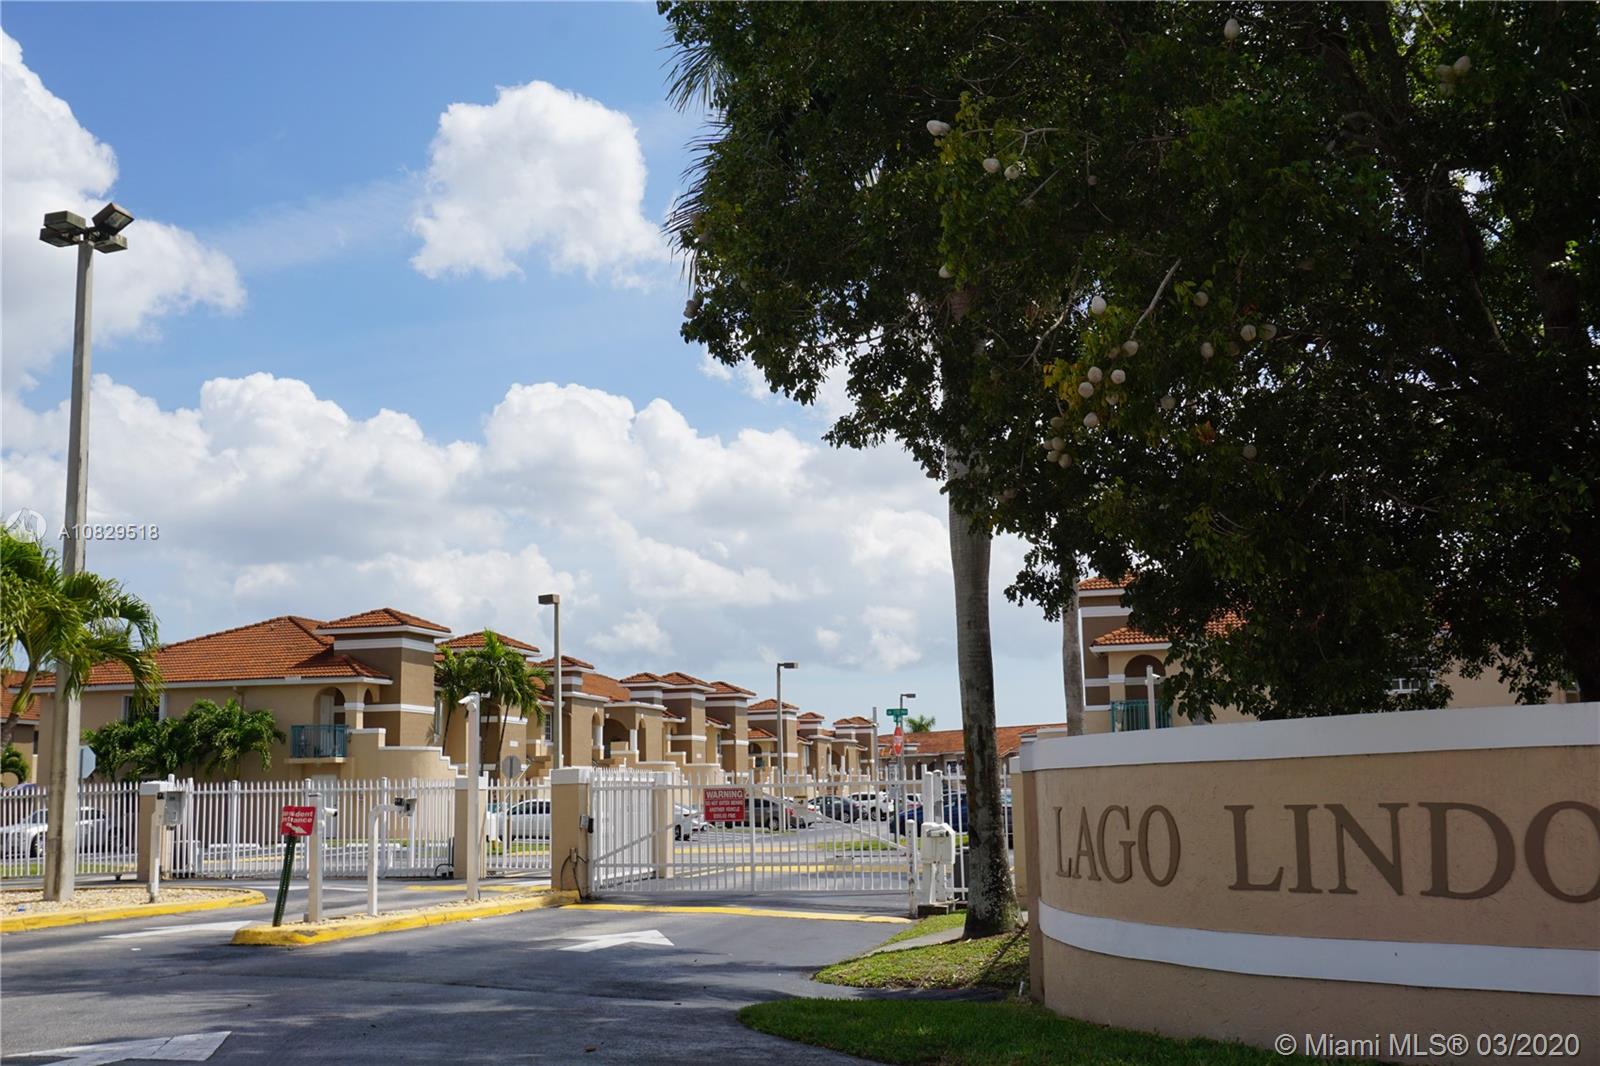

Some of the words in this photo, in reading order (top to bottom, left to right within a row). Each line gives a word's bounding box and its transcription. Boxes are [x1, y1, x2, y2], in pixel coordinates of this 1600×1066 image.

[705, 790, 743, 799] WARNING
[1053, 804, 1181, 888] LAGO
[1223, 800, 1600, 904] LINDO
